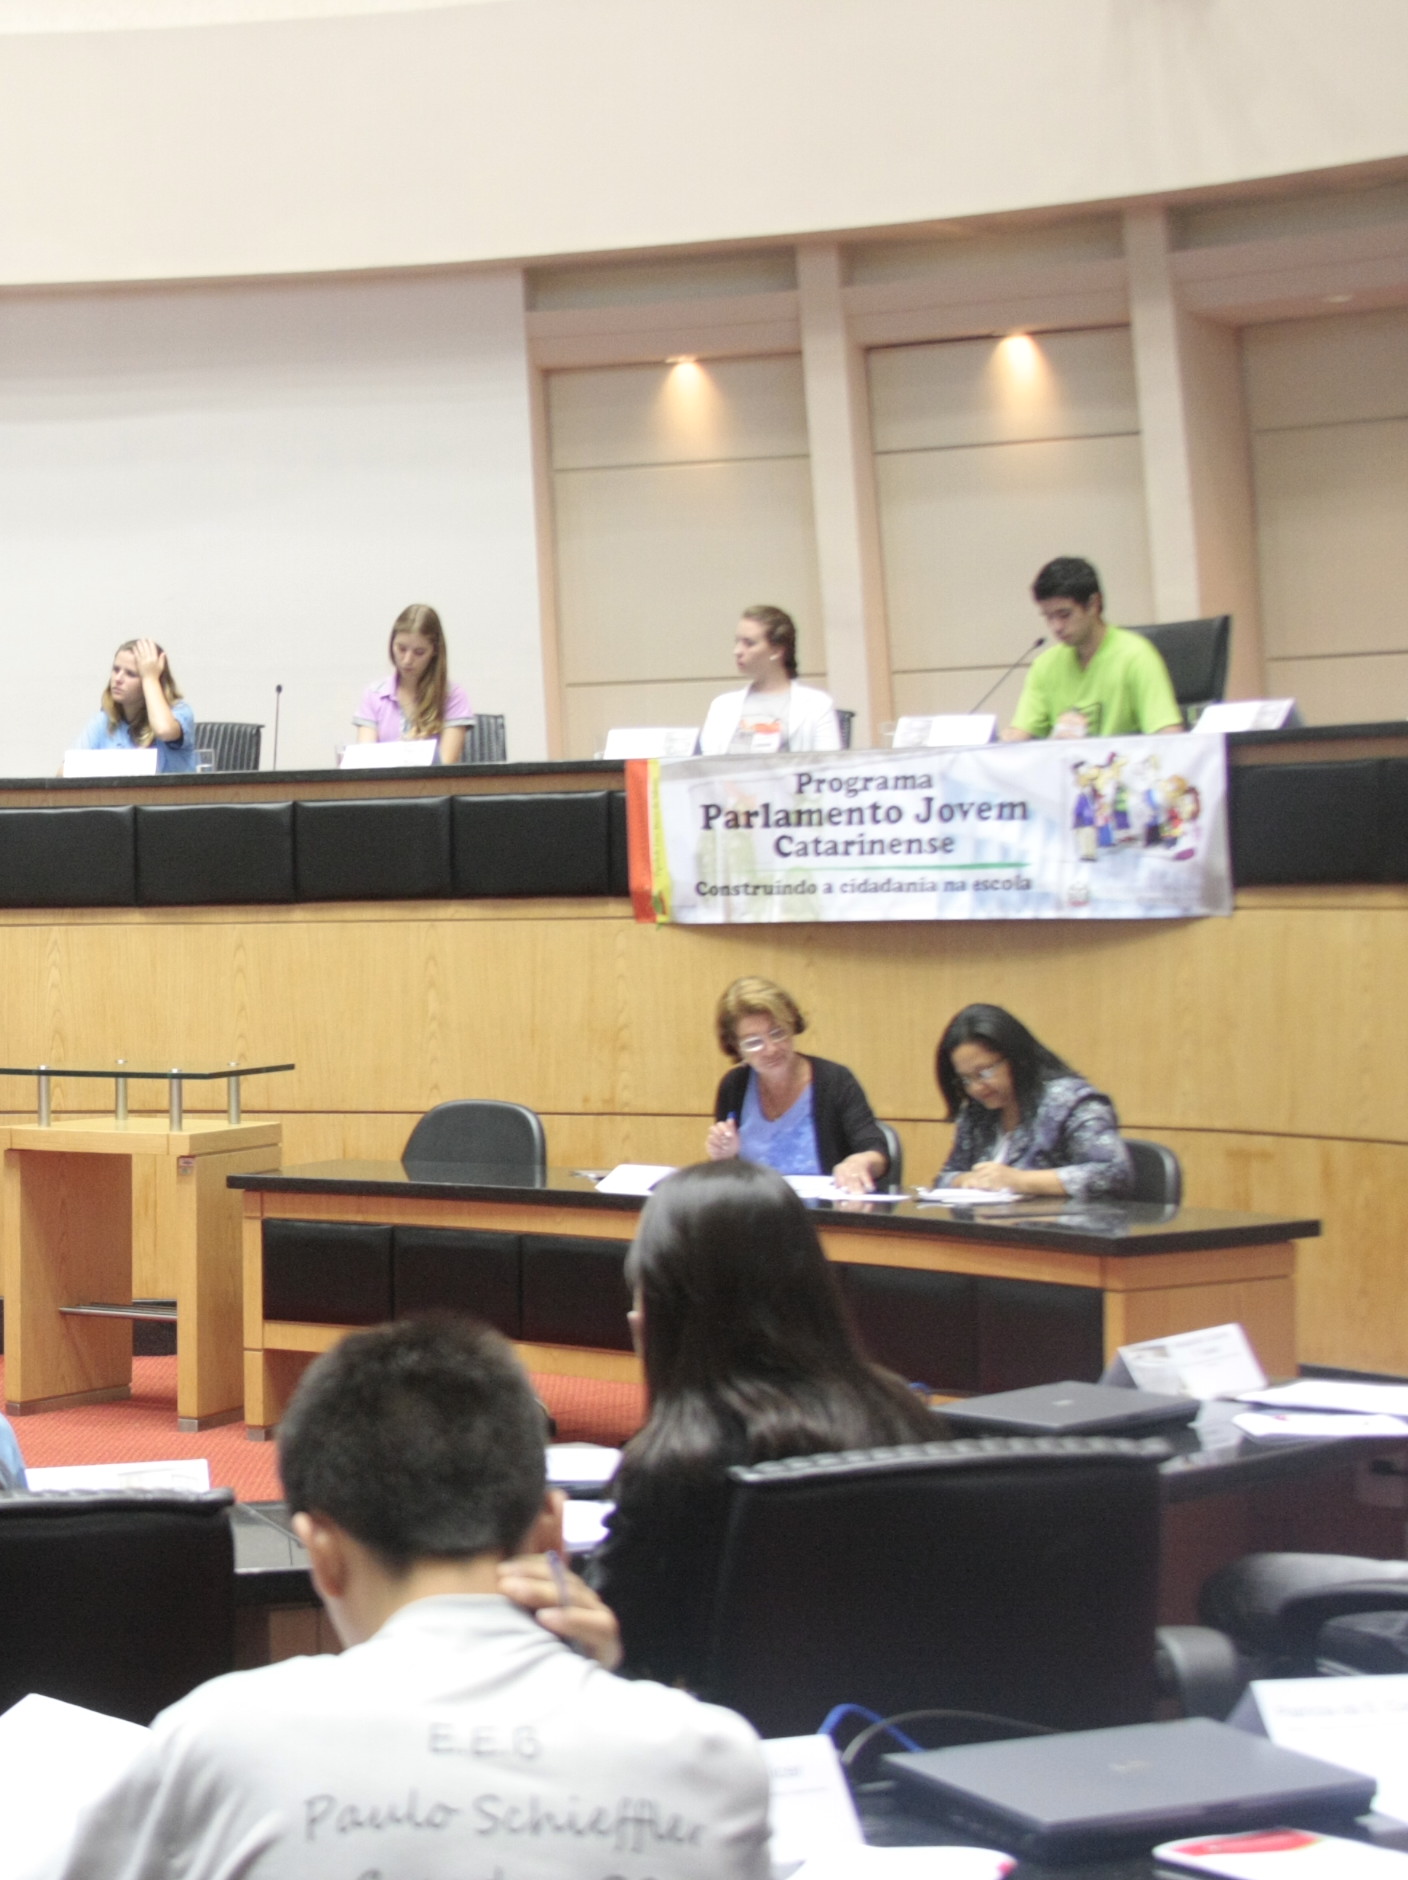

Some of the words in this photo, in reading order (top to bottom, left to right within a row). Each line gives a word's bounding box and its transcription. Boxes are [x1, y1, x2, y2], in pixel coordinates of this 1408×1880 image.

[794, 771, 934, 797] Programa
[700, 801, 904, 831] Parlamento
[913, 797, 1030, 824] Jovem
[773, 832, 955, 858] Catarinense
[695, 878, 818, 898] Construindo
[824, 882, 834, 895] a
[838, 878, 939, 895] cidadania
[943, 880, 968, 893] na
[973, 875, 1032, 893] escola
[303, 1788, 460, 1840] Paulo
